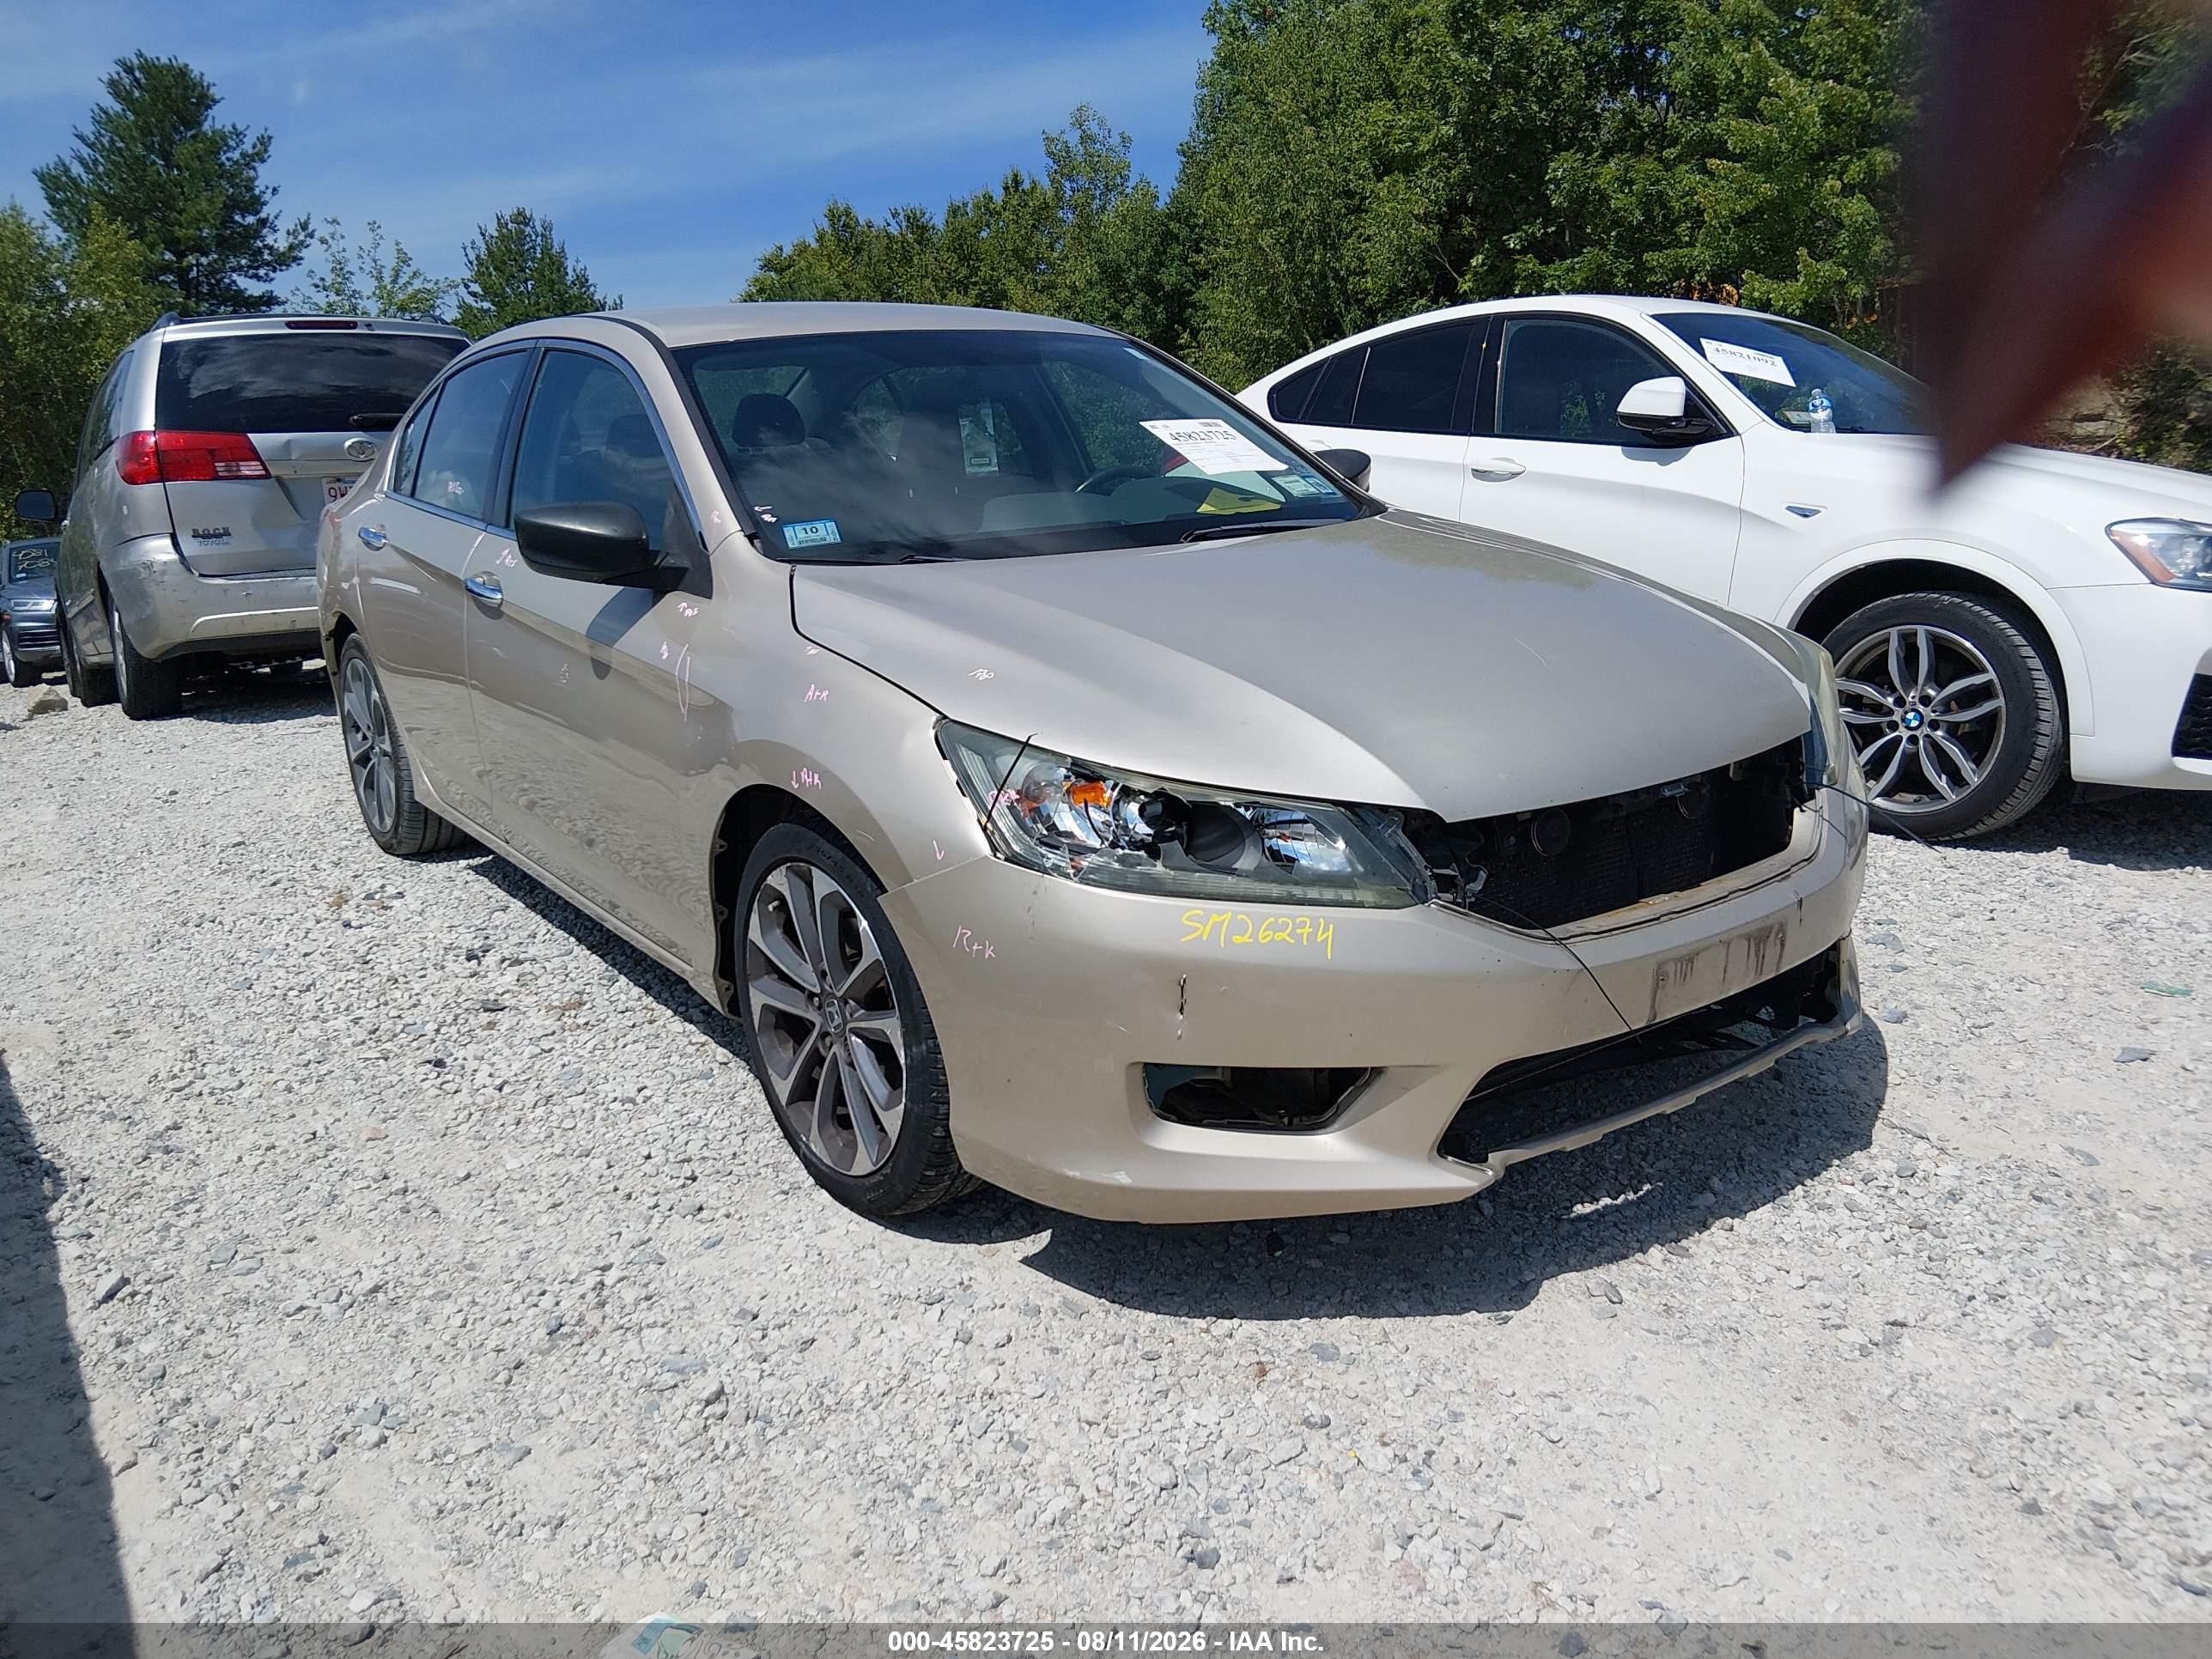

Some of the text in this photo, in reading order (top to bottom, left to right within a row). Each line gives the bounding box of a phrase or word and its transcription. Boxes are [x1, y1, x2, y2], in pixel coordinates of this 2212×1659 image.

[1170, 430, 1237, 442] 45823725
[801, 526, 818, 535] 10
[1181, 908, 1334, 961] SM26274
